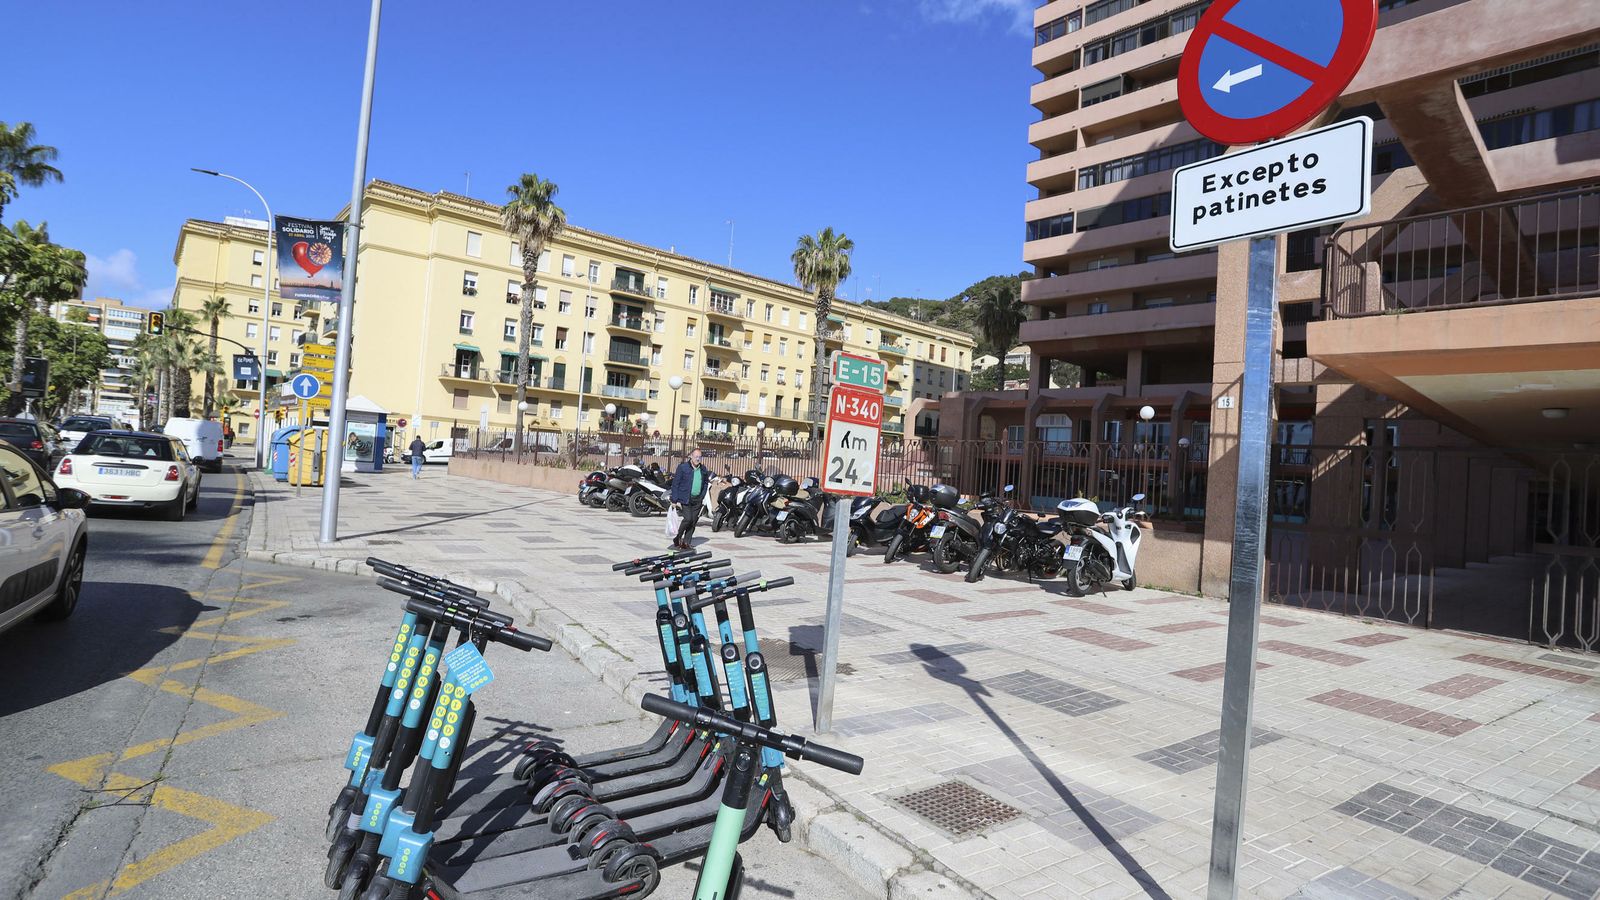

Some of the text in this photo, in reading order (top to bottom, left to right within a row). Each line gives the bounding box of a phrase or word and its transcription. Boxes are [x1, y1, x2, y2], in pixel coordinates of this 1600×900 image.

[1202, 153, 1319, 193] Excepto
[1193, 178, 1327, 225] patinetes
[282, 227, 314, 235] SOLIDARIO
[287, 222, 314, 230] FESTIVAL
[838, 359, 881, 386] E-15
[835, 394, 879, 420] N-340
[1222, 398, 1231, 407] 15
